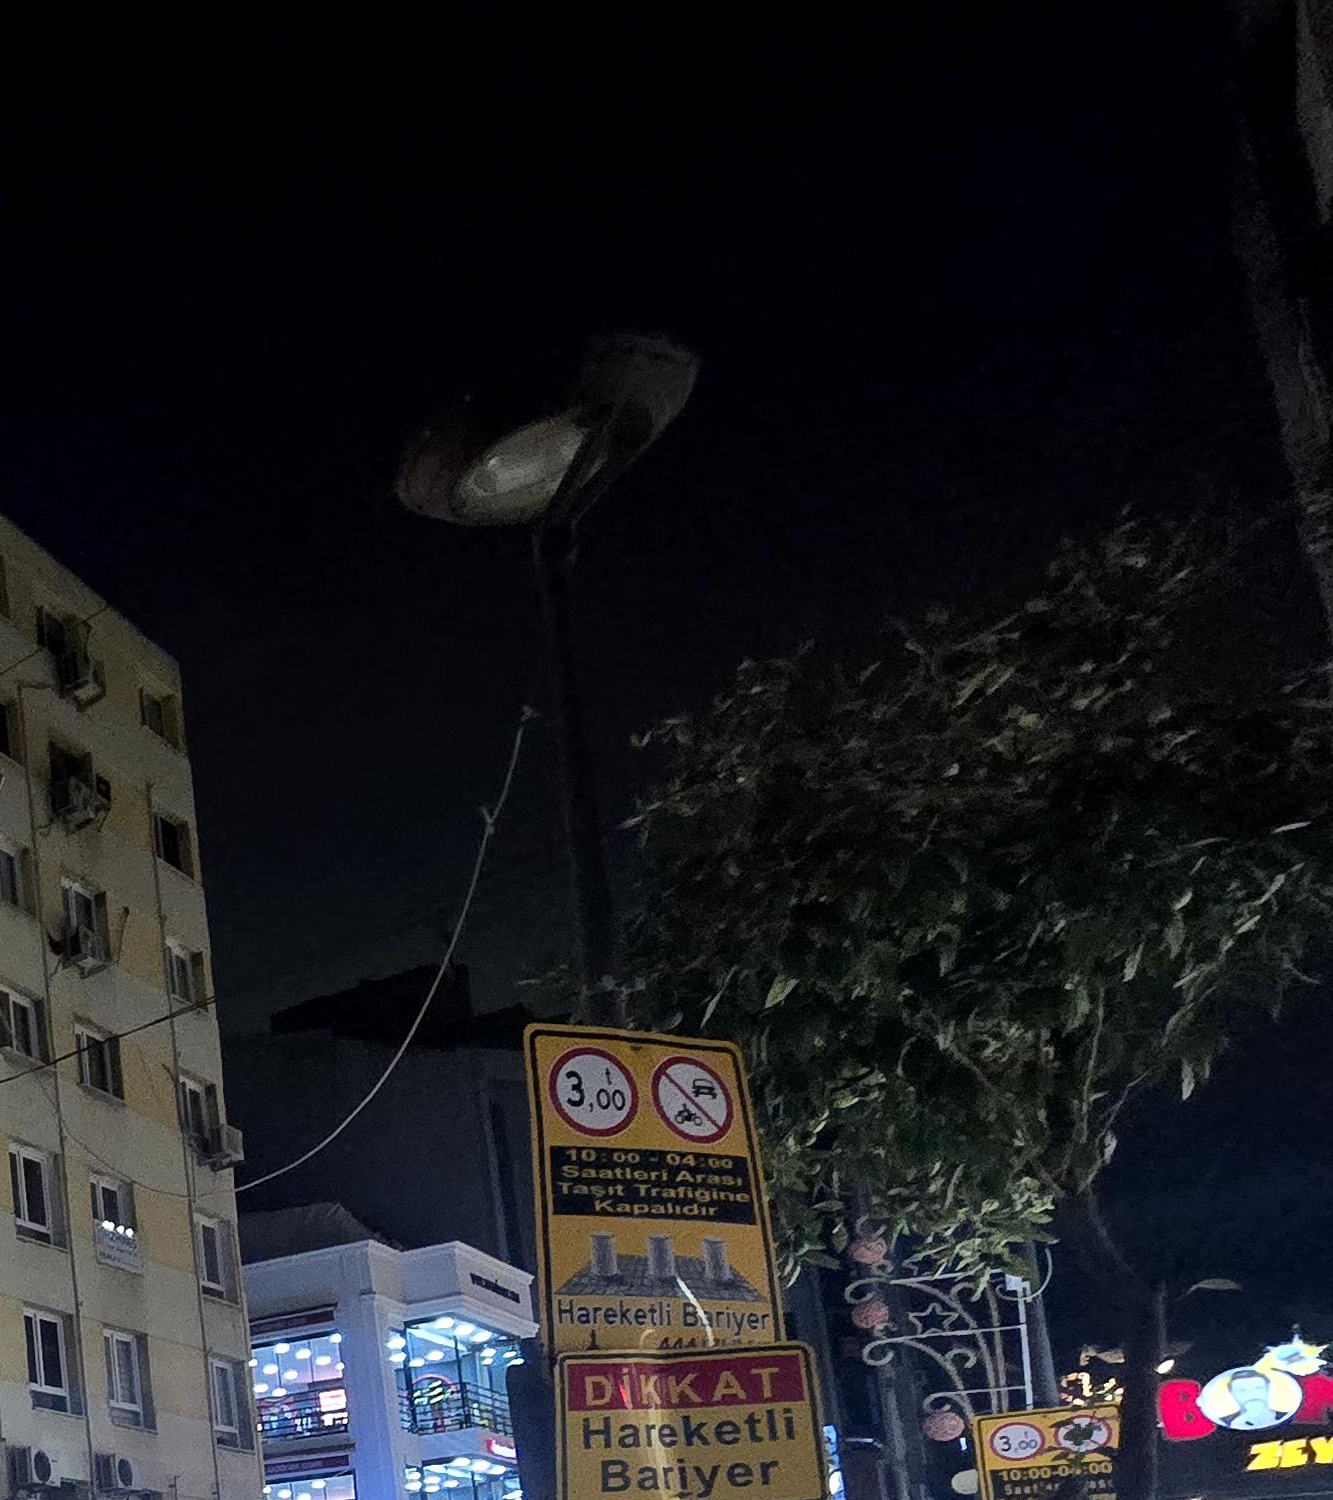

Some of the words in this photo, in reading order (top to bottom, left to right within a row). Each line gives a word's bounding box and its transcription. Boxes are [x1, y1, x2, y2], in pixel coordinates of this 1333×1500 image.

[565, 1070, 626, 1112] 3,00
[558, 1181, 623, 1197] Taşıt
[633, 1183, 750, 1203] Trafiğine
[561, 1164, 668, 1181] Saatleri
[676, 1168, 742, 1187] Arası
[594, 1199, 719, 1217] Kapalıdır
[557, 1299, 671, 1327] Hareketli
[683, 1303, 770, 1335] Bariyer
[584, 1367, 779, 1410] DİKKAT
[582, 1408, 796, 1450] Hareketli
[600, 1458, 780, 1499] Bariyer
